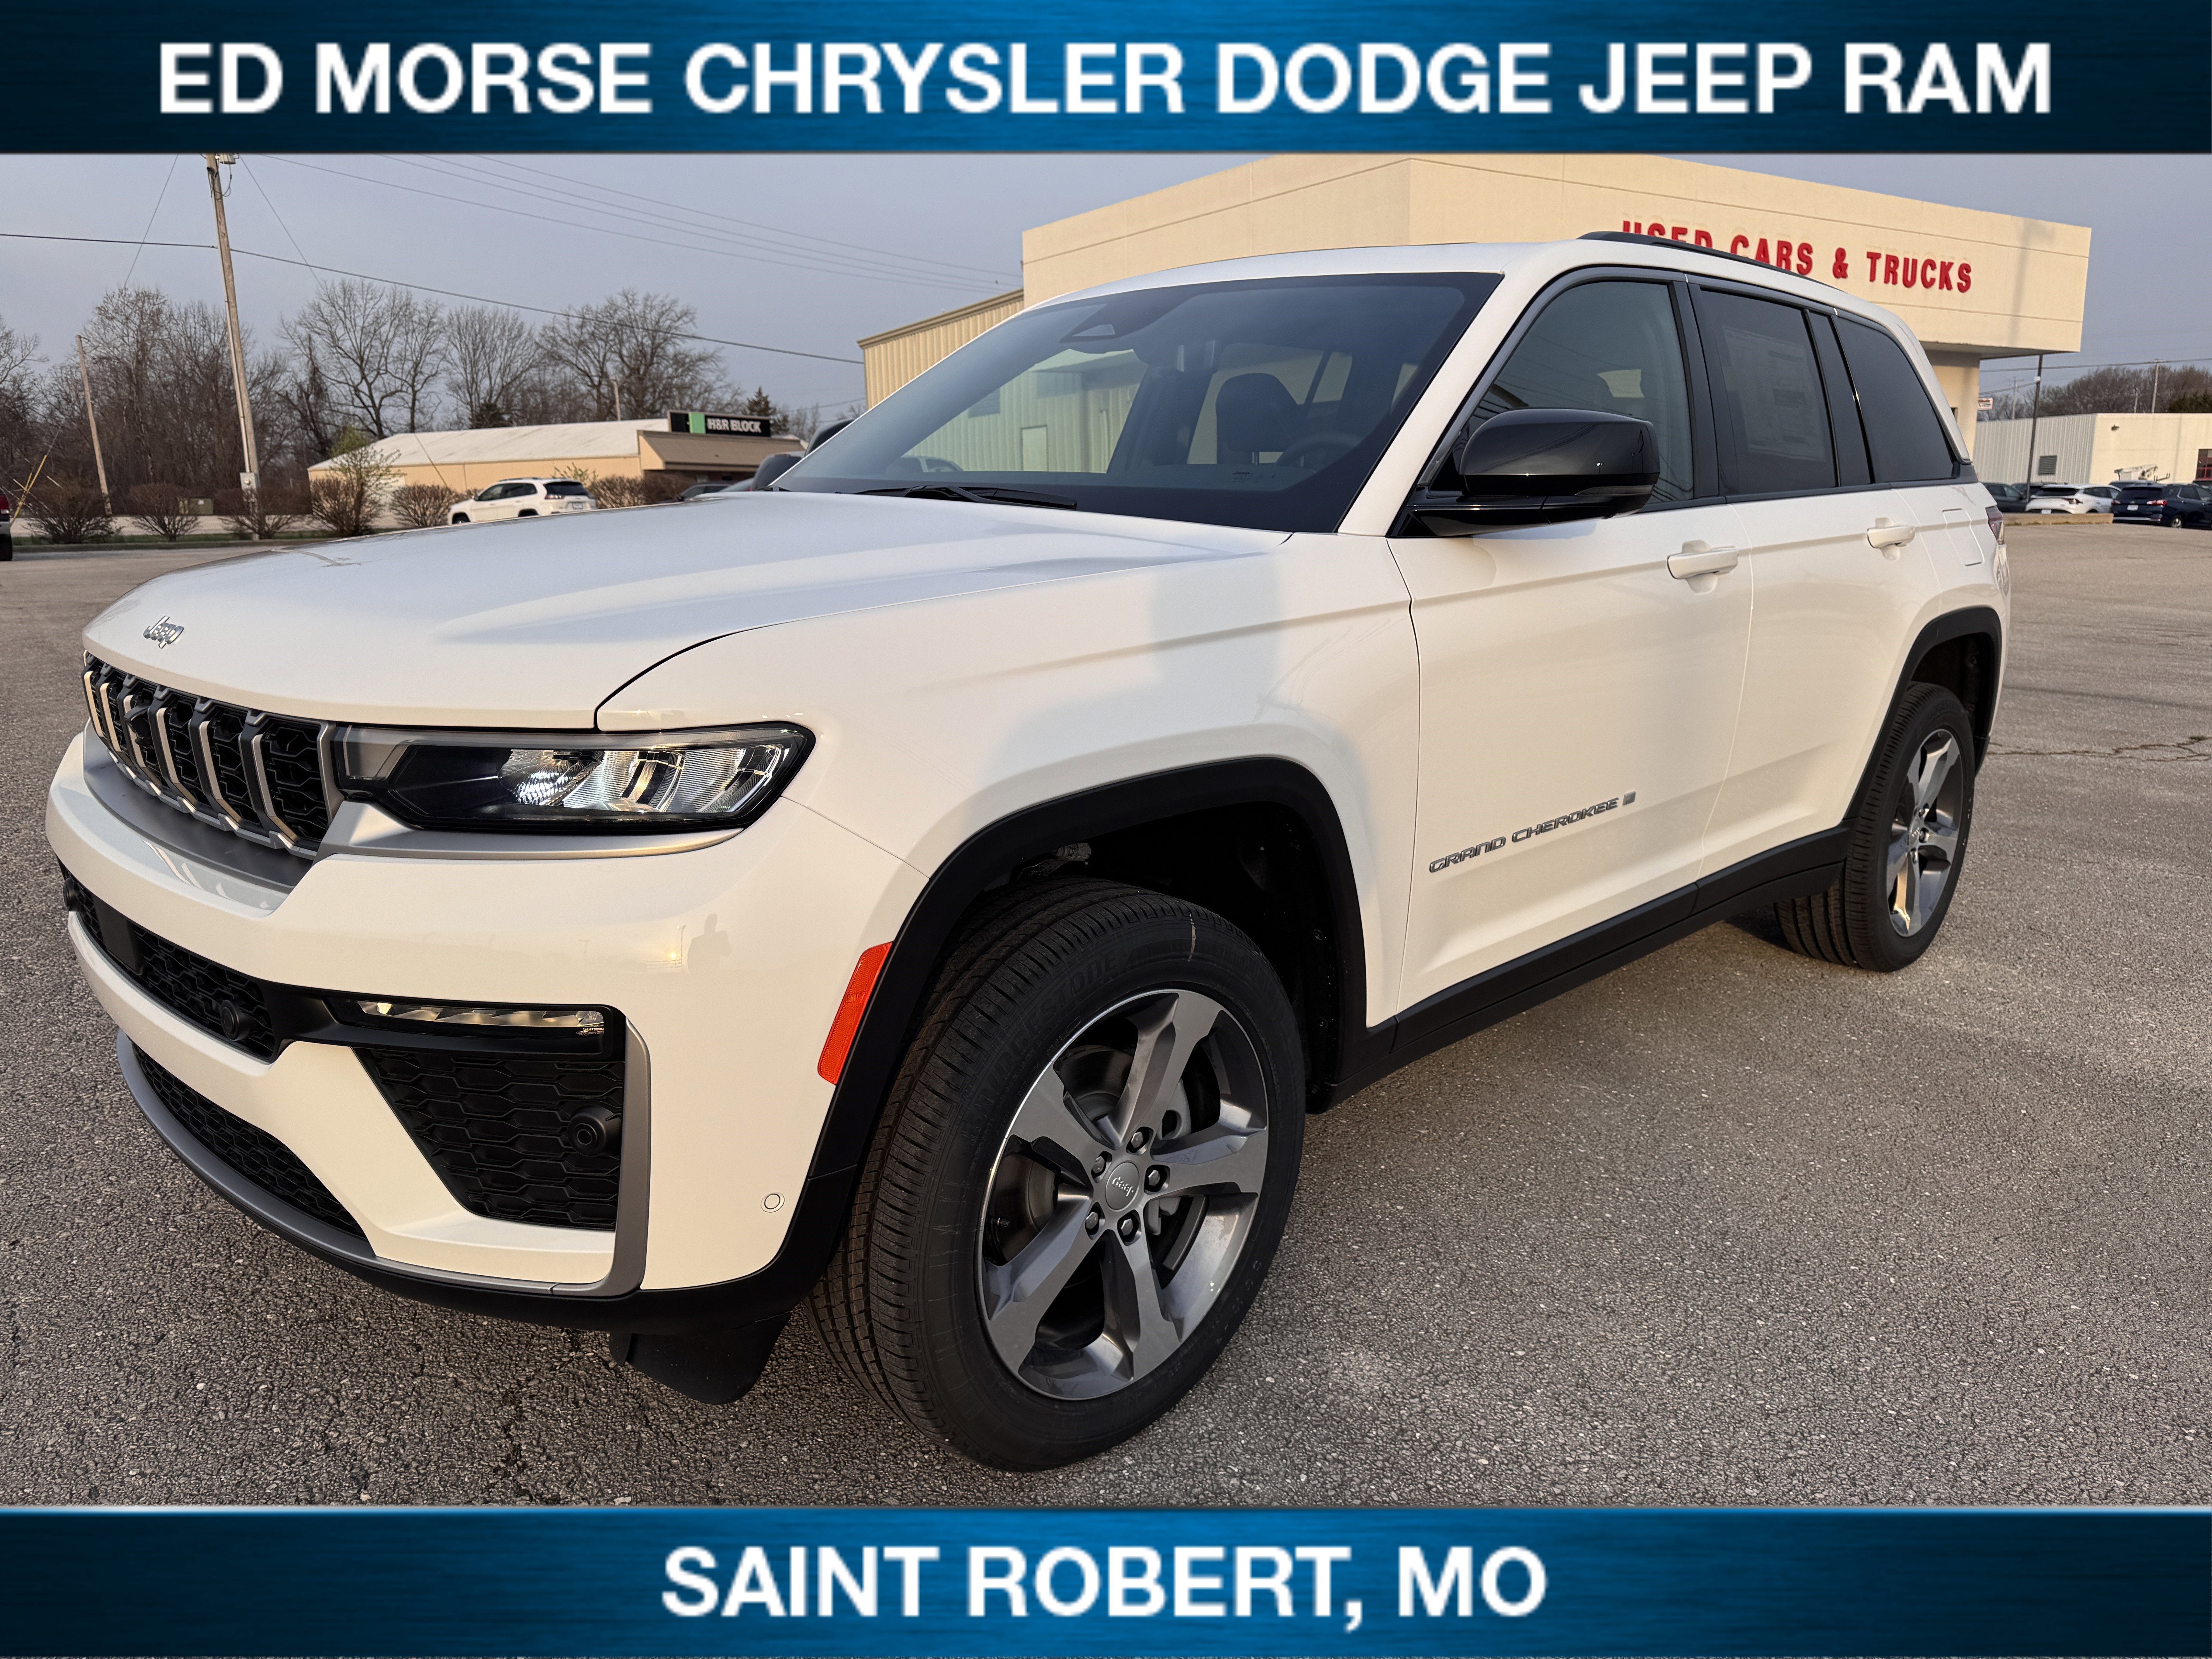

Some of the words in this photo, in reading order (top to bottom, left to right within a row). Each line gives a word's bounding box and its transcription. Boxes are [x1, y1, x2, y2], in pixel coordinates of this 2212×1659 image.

[1730, 235, 1814, 275] CARS
[1832, 247, 1849, 279] &
[1866, 251, 1972, 294] TRUCKS
[707, 418, 730, 431] H&R
[730, 419, 762, 433] BLOCK
[143, 615, 184, 649] Jeep
[1429, 836, 1506, 874] GRAND
[1511, 797, 1619, 843] CHEROKEE
